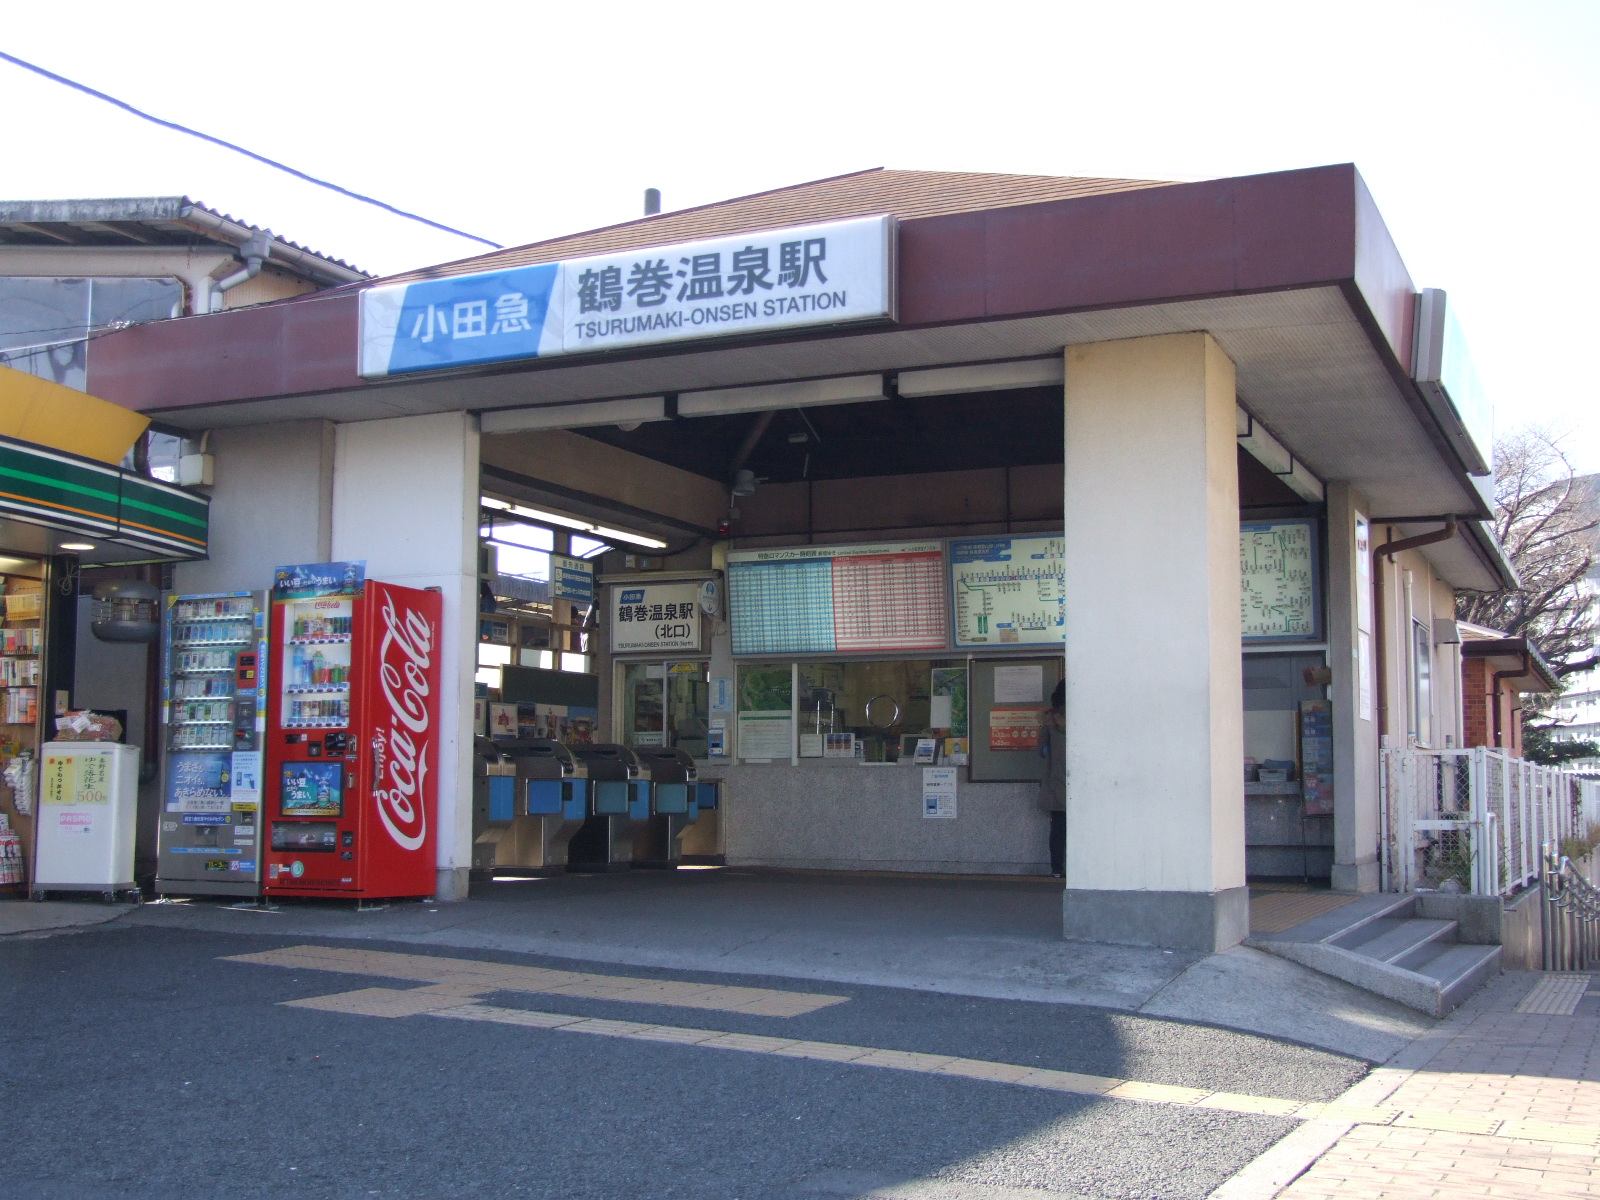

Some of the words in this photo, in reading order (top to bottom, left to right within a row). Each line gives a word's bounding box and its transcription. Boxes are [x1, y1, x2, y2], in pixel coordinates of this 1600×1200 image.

[577, 236, 828, 315] 鶴巻温泉駅
[411, 291, 533, 343] 小田急
[575, 301, 757, 340] TSURUMAKI-ONSEN
[762, 290, 847, 318] STATION
[618, 602, 694, 622] 鶴巻温泉駅
[655, 623, 691, 639] (北口)
[376, 588, 432, 851] Coca-Cola
